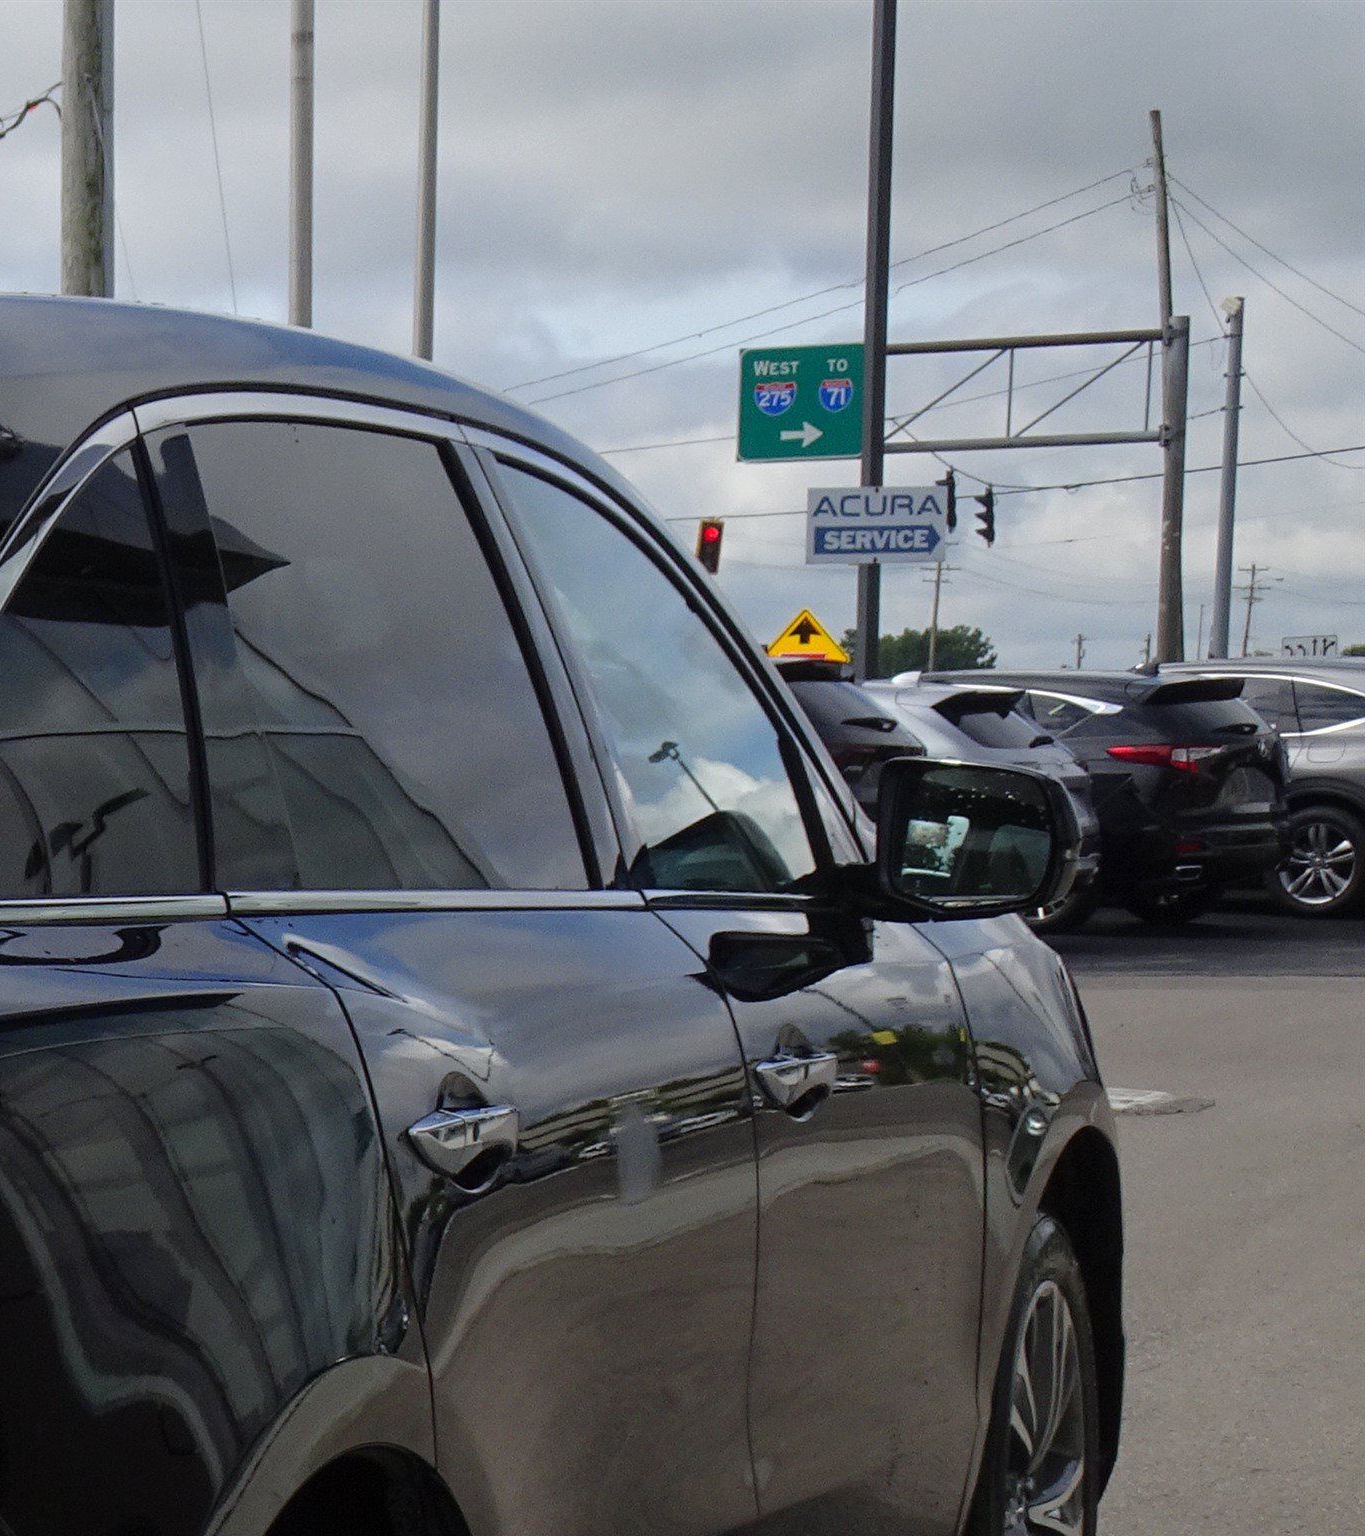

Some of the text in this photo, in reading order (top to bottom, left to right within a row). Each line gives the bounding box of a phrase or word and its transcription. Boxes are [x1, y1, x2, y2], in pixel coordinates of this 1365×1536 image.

[753, 360, 799, 376] WEST
[827, 358, 848, 373] TO
[758, 389, 792, 407] 275
[827, 388, 846, 406] 71
[813, 494, 942, 518] ACURA
[823, 529, 930, 551] SERVICE
